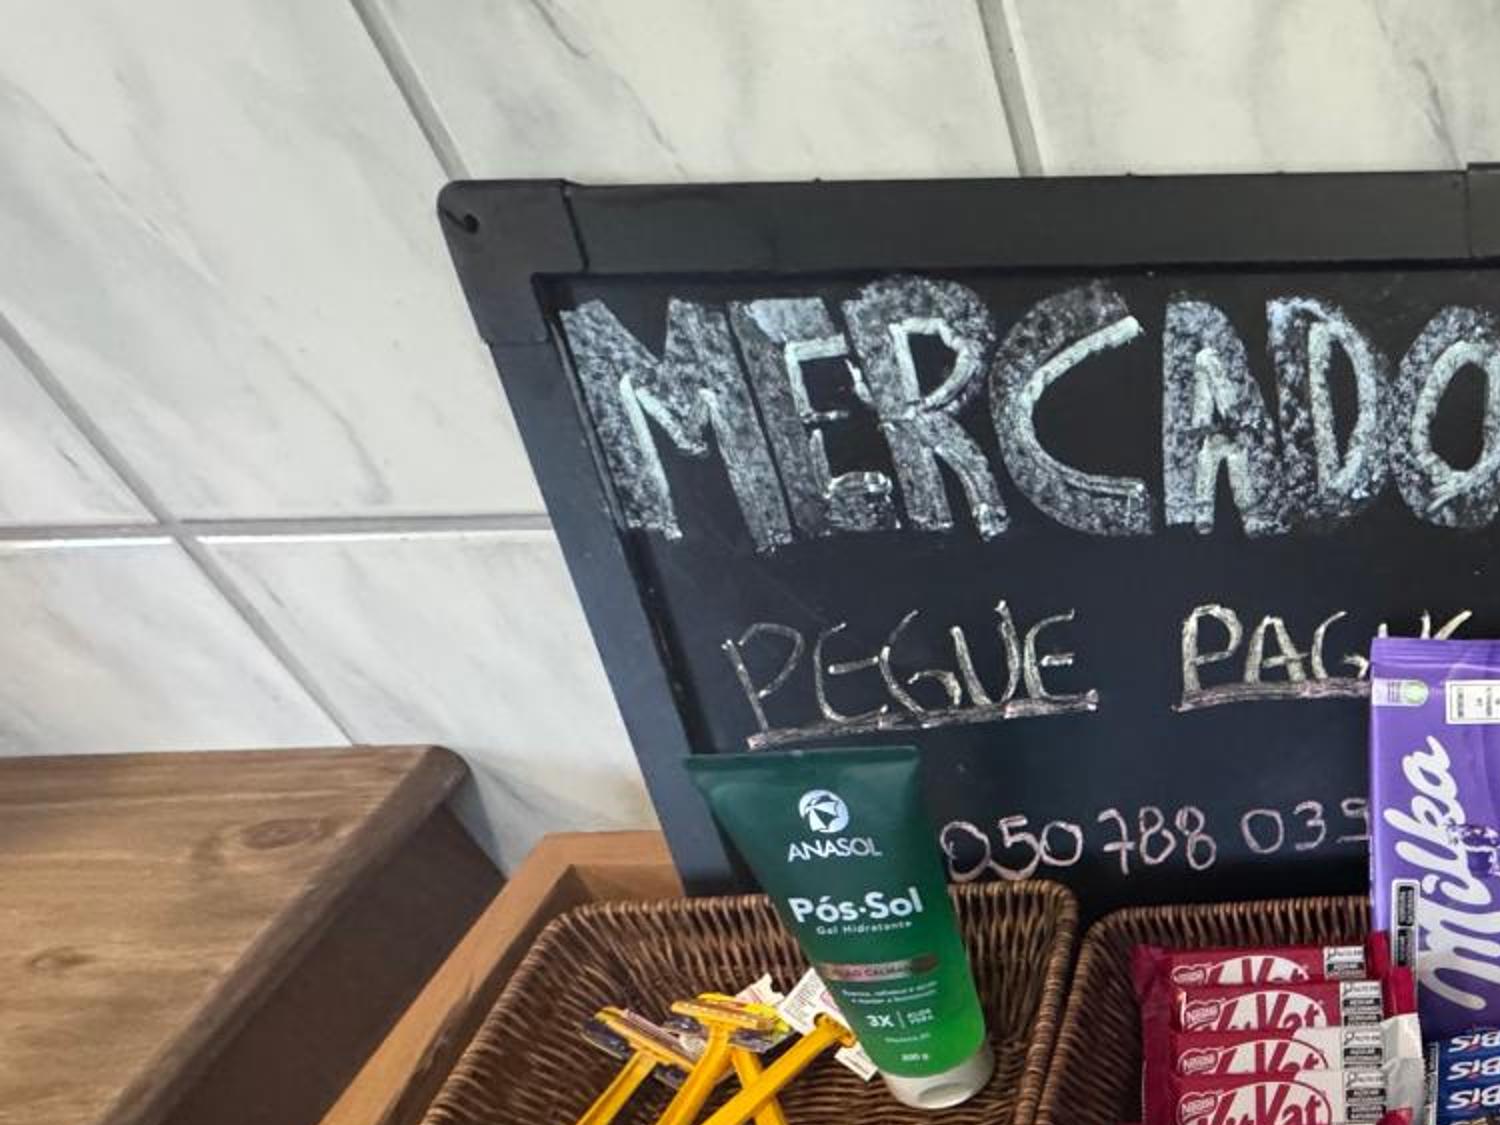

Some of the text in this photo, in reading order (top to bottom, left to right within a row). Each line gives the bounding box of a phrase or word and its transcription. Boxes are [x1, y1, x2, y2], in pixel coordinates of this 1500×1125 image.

[721, 600, 1472, 733] PEGUE PAG
[788, 838, 882, 862] ANASOL
[1097, 806, 1216, 875] 788
[867, 1014, 895, 1028] 3X
